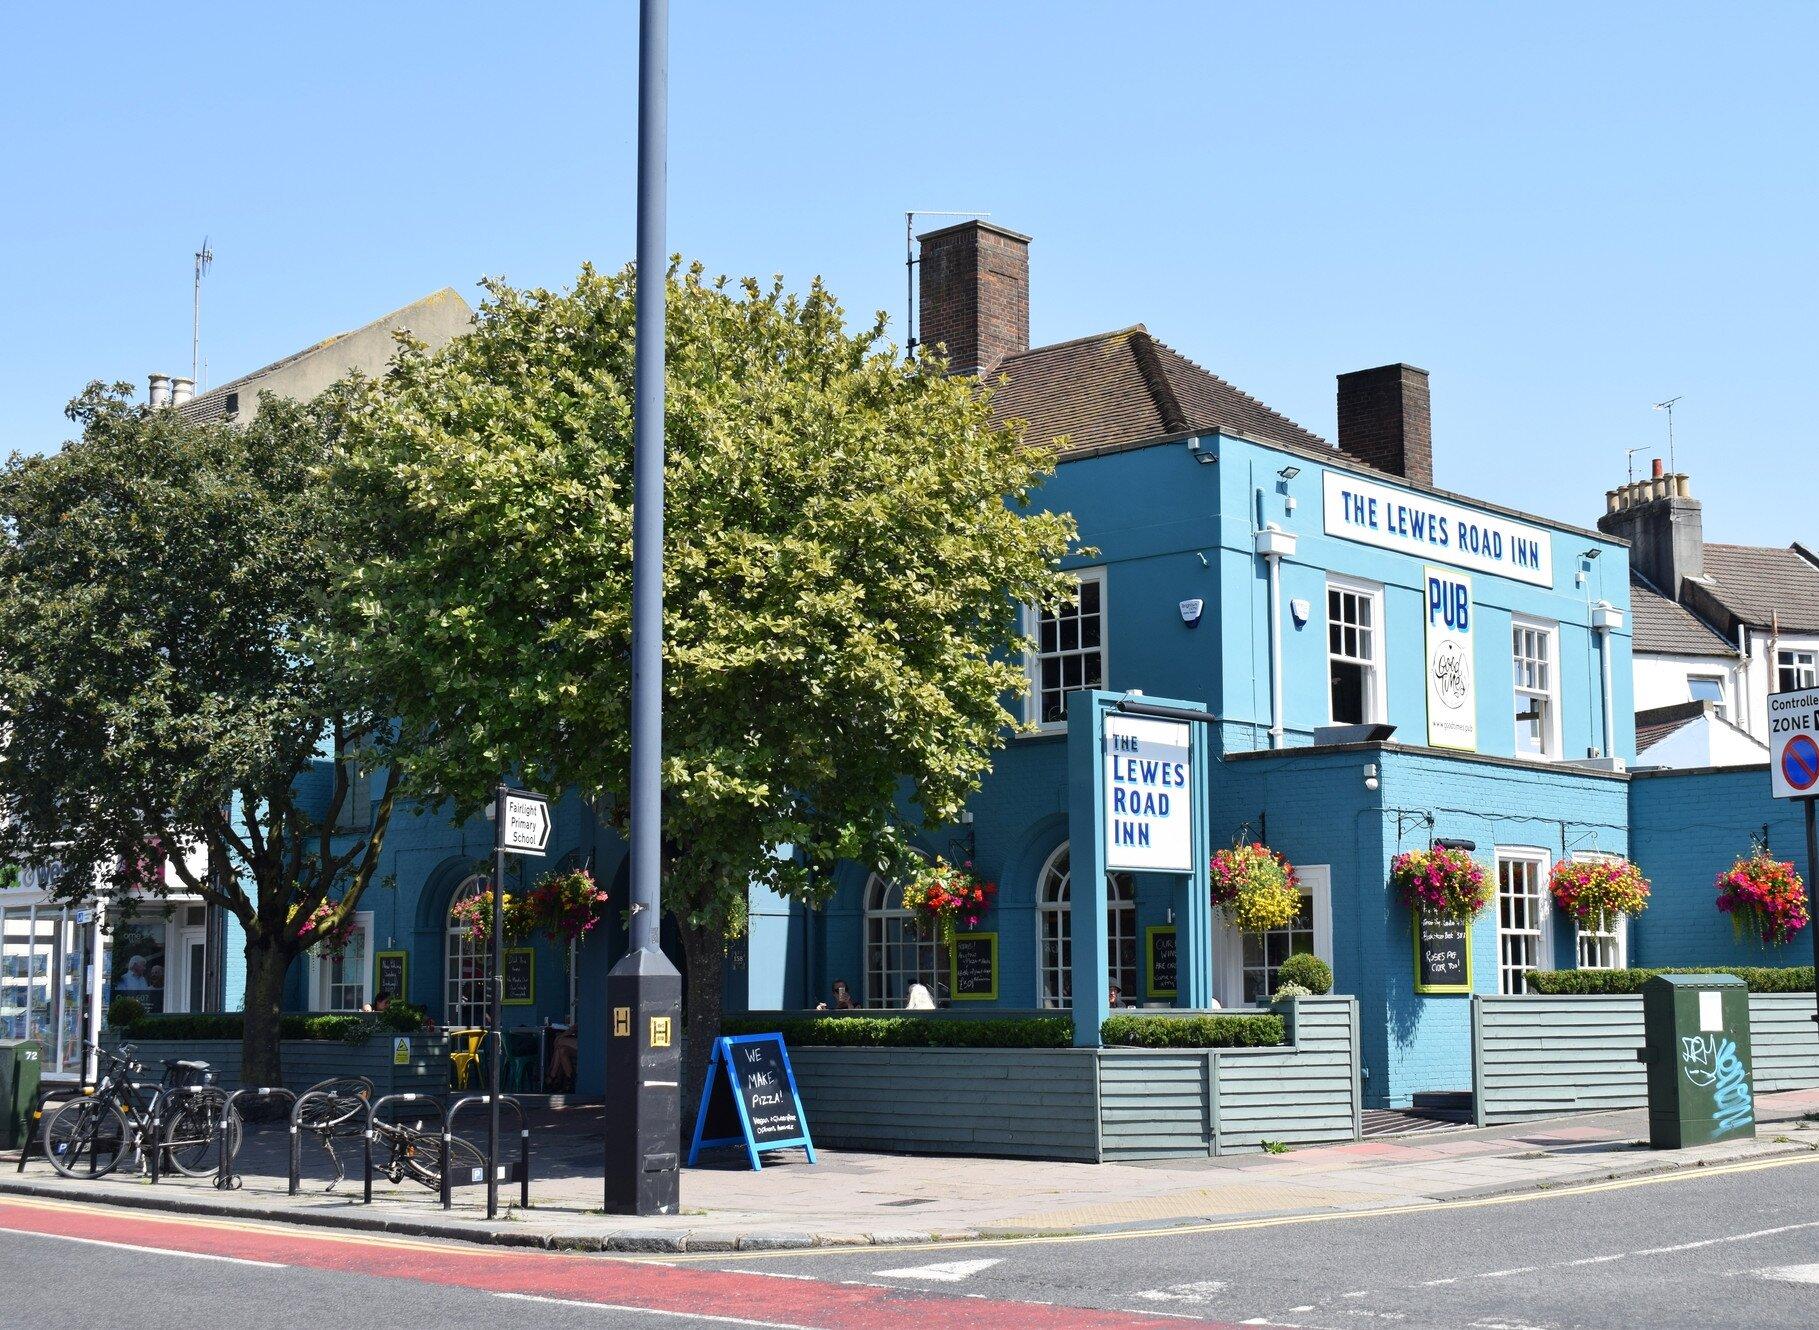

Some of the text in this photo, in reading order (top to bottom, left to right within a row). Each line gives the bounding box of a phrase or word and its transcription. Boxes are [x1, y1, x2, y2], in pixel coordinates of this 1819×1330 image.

[1341, 490, 1540, 569] THE LEWES ROAD INN
[1428, 576, 1469, 630] PUB
[1772, 695, 1819, 711] Controlle
[1772, 714, 1810, 733] ZONE
[1112, 733, 1139, 752] THE
[1113, 755, 1186, 787] LEWES
[509, 801, 537, 817] Fairlight
[1113, 786, 1170, 817] ROAD
[511, 816, 537, 832] Primary
[1114, 819, 1151, 846] INN
[512, 831, 536, 845] School
[616, 1010, 628, 1034] H
[653, 1020, 668, 1044] H
[25, 1050, 38, 1061] 72
[744, 1047, 763, 1063] WE
[748, 1070, 775, 1089] MAKE
